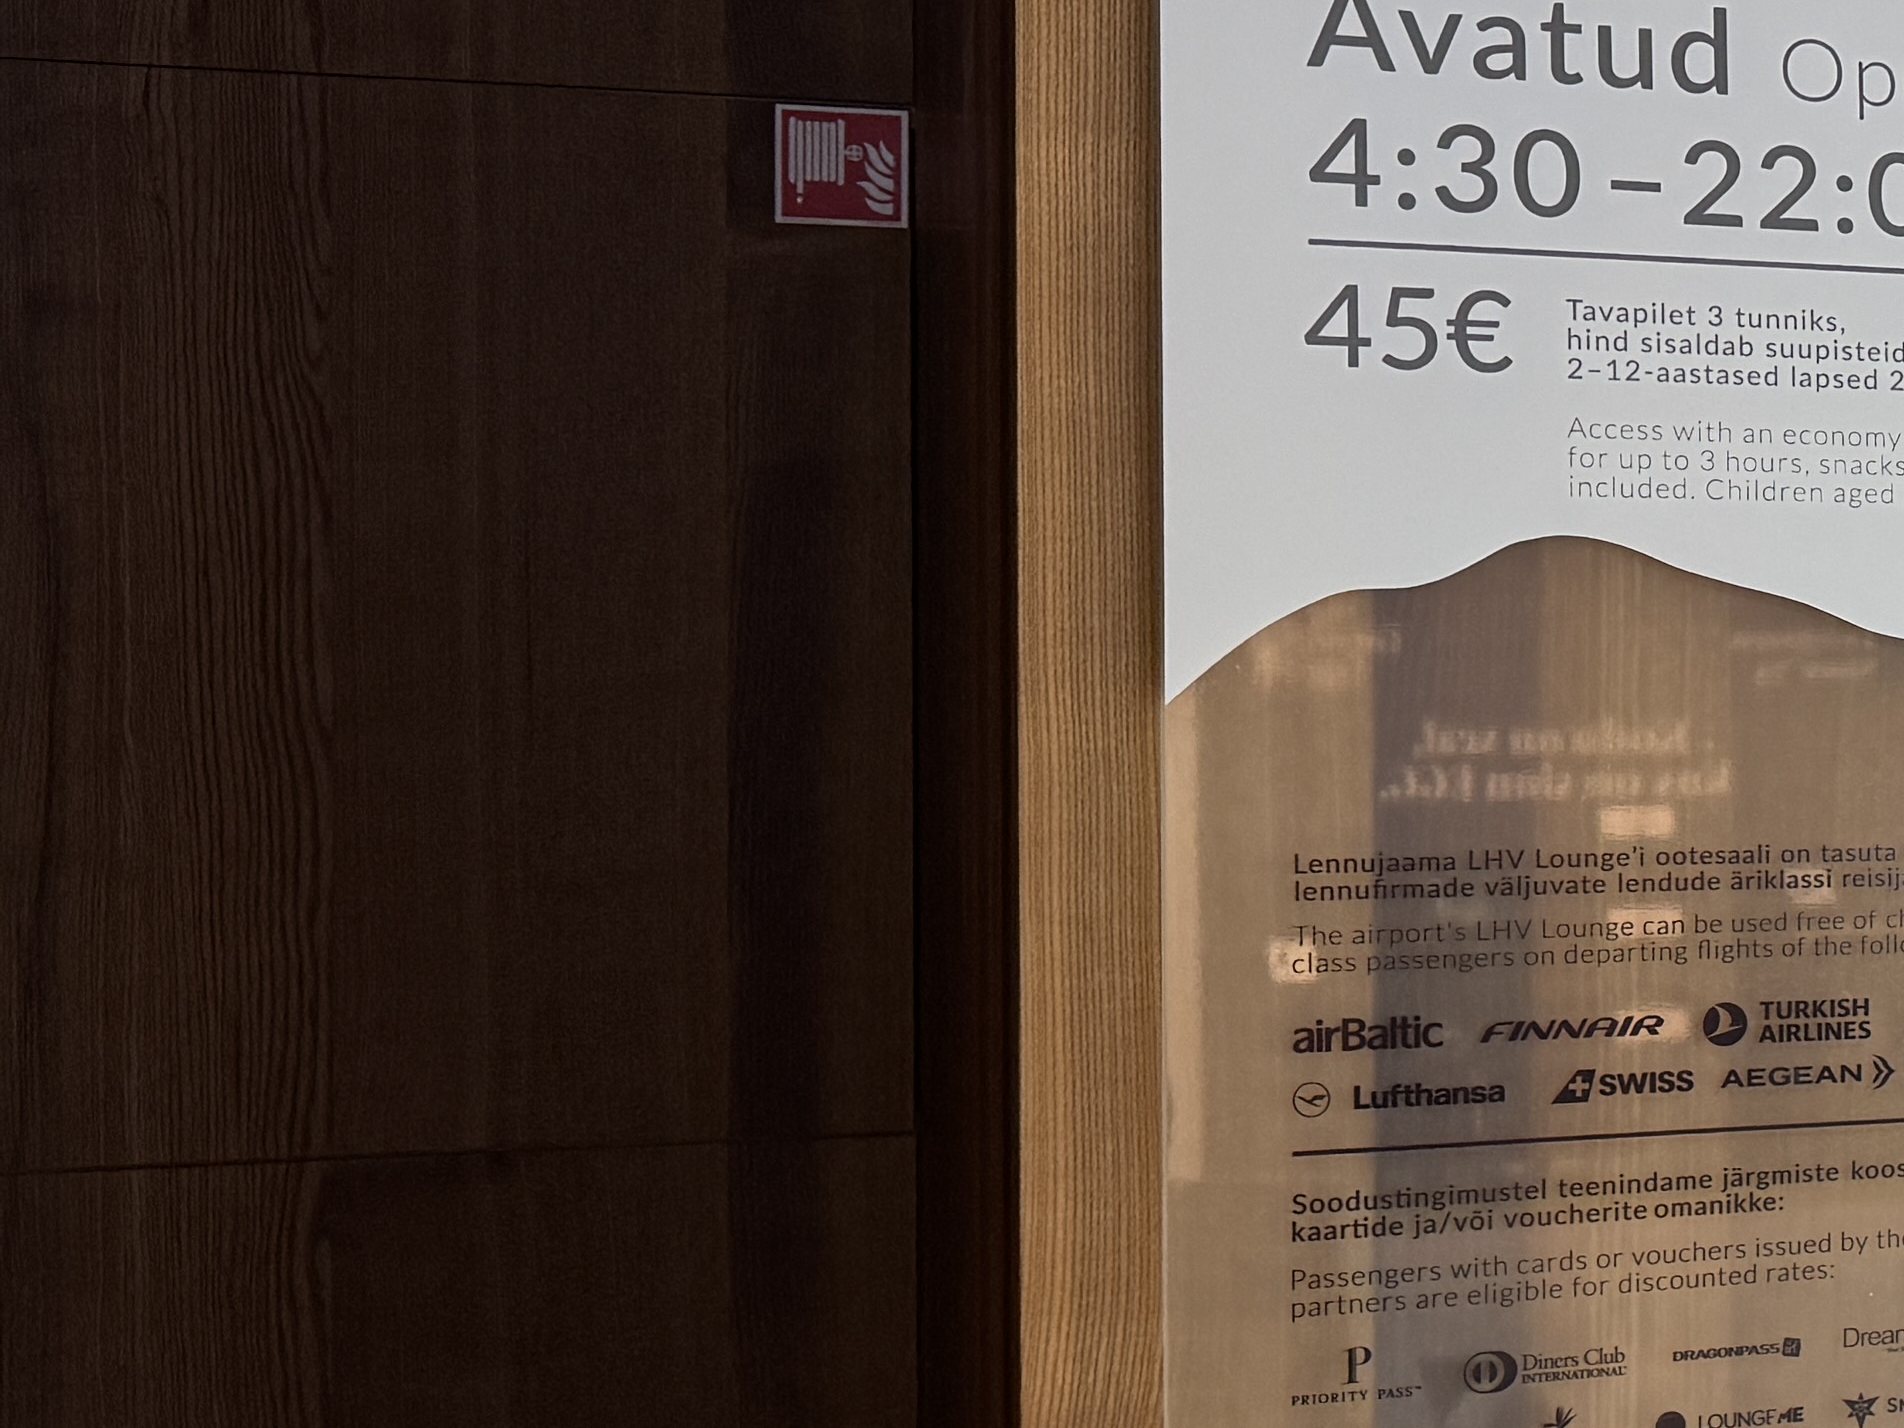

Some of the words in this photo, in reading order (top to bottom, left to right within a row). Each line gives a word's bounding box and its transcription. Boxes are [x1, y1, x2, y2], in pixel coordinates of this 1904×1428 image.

[1304, 284, 1513, 373] 45€
[1566, 300, 1696, 329] Tavapilet
[1708, 305, 1724, 327] 3
[1736, 305, 1845, 336] tunniks,
[1566, 327, 1629, 355] hind
[1640, 329, 1754, 358] sisaldab
[1765, 336, 1904, 367] suupisteid
[1790, 362, 1878, 396] lapsed
[1568, 417, 1663, 445] Access
[1672, 418, 1732, 445] with
[1742, 425, 1774, 446] an
[1782, 426, 1902, 455] economy
[1568, 446, 1609, 473] for
[1619, 452, 1653, 478] up
[1662, 449, 1690, 474] to
[1700, 450, 1715, 473] 3
[1725, 450, 1810, 481] hours,
[1568, 476, 1695, 502] included.
[1705, 476, 1824, 506] Children
[1833, 481, 1895, 512] aged
[1294, 853, 1455, 877] Lennujaama
[1469, 850, 1525, 870] LHV
[1656, 844, 1771, 867] ootesaali
[1780, 849, 1810, 864] on
[1821, 844, 1896, 863] tasuta
[1294, 878, 1474, 902] lennufirmade
[1485, 874, 1606, 901] väljuvate
[1618, 871, 1721, 894] lendude
[1731, 869, 1832, 890] äriklassi
[1293, 924, 1342, 947] The
[1477, 920, 1532, 941] LHV
[1542, 918, 1633, 943] Lounge
[1643, 916, 1684, 936] can
[1694, 913, 1722, 933] be
[1731, 912, 1787, 933] used
[1796, 909, 1845, 931] free
[1853, 908, 1878, 930] of
[1292, 951, 1356, 974] class
[1367, 948, 1515, 975] passengers
[1524, 949, 1555, 967] on
[1564, 938, 1687, 966] departing
[1698, 936, 1773, 965] flights
[1782, 936, 1806, 957] of
[1814, 935, 1852, 956] the
[1759, 998, 1870, 1021] TURKISH
[1293, 1016, 1443, 1054] airBaltic
[1480, 1014, 1665, 1044] FINNAIR
[1758, 1019, 1871, 1044] AIRLINES
[1599, 1070, 1694, 1096] SWISS
[1721, 1063, 1862, 1088] AEGEAN
[1353, 1083, 1505, 1110] Lufthansa
[1292, 1179, 1546, 1215] Soodustingimustel
[1559, 1172, 1712, 1199] teenindame
[1721, 1164, 1839, 1193] järgmiste
[1291, 1216, 1403, 1243] kaartide
[1412, 1208, 1493, 1241] ja/või
[1503, 1199, 1647, 1229] voucherite
[1654, 1191, 1784, 1219] omanikke:
[1291, 1262, 1441, 1292] Passengers
[1451, 1255, 1507, 1280] with
[1517, 1250, 1587, 1275] cards
[1596, 1251, 1623, 1270] or
[1632, 1240, 1746, 1267] vouchers
[1755, 1232, 1831, 1258] issued
[1841, 1231, 1869, 1255] by
[1291, 1295, 1406, 1323] partners
[1416, 1292, 1457, 1311] are
[1467, 1281, 1562, 1307] eligible
[1572, 1276, 1609, 1298] for
[1618, 1264, 1757, 1295] discounted
[1766, 1261, 1835, 1283] rates:
[1521, 1353, 1579, 1371] Diners
[1584, 1347, 1625, 1365] Club
[1672, 1343, 1780, 1362] DRAGONPASS
[1291, 1389, 1368, 1406] PRIORITY
